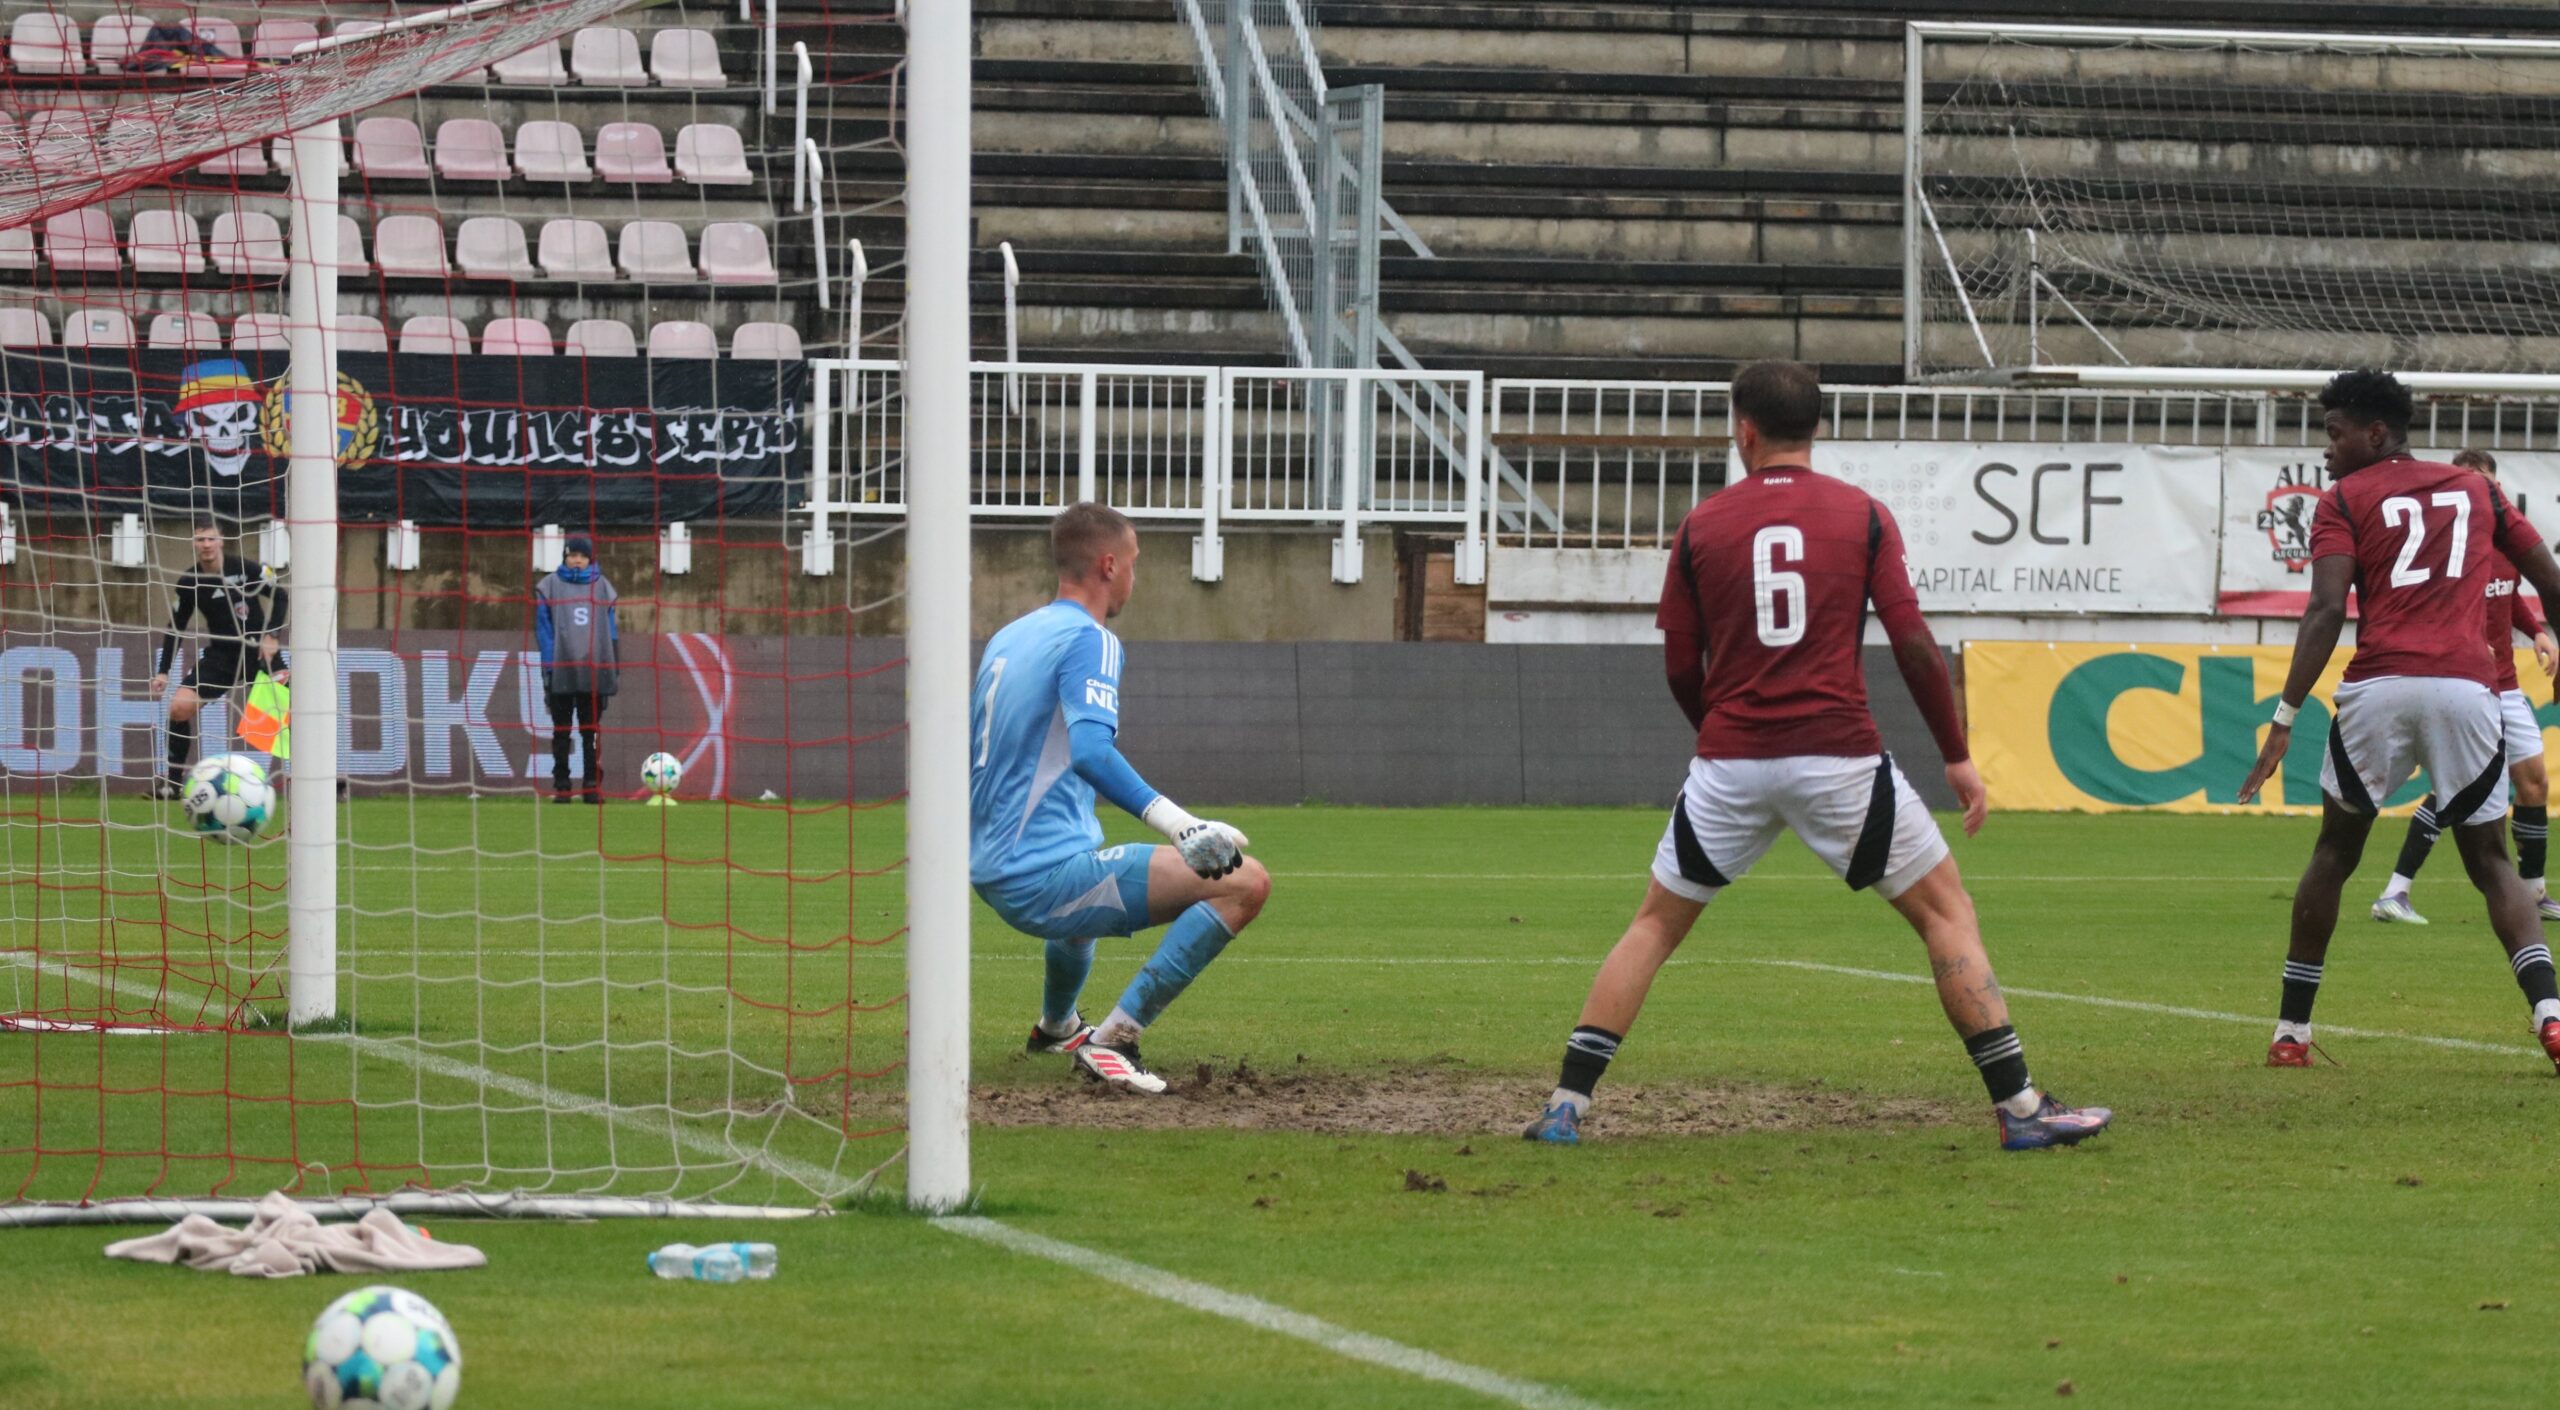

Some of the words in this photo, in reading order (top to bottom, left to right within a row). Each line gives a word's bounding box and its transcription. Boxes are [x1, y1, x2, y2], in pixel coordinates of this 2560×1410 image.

[1971, 462, 2124, 546] SCF
[2381, 490, 2471, 589] 27
[573, 606, 589, 626] S
[1753, 525, 1806, 647] 6
[1910, 567, 2002, 593] APITAL
[2013, 567, 2122, 593] FINANCE
[977, 657, 1008, 768] 1
